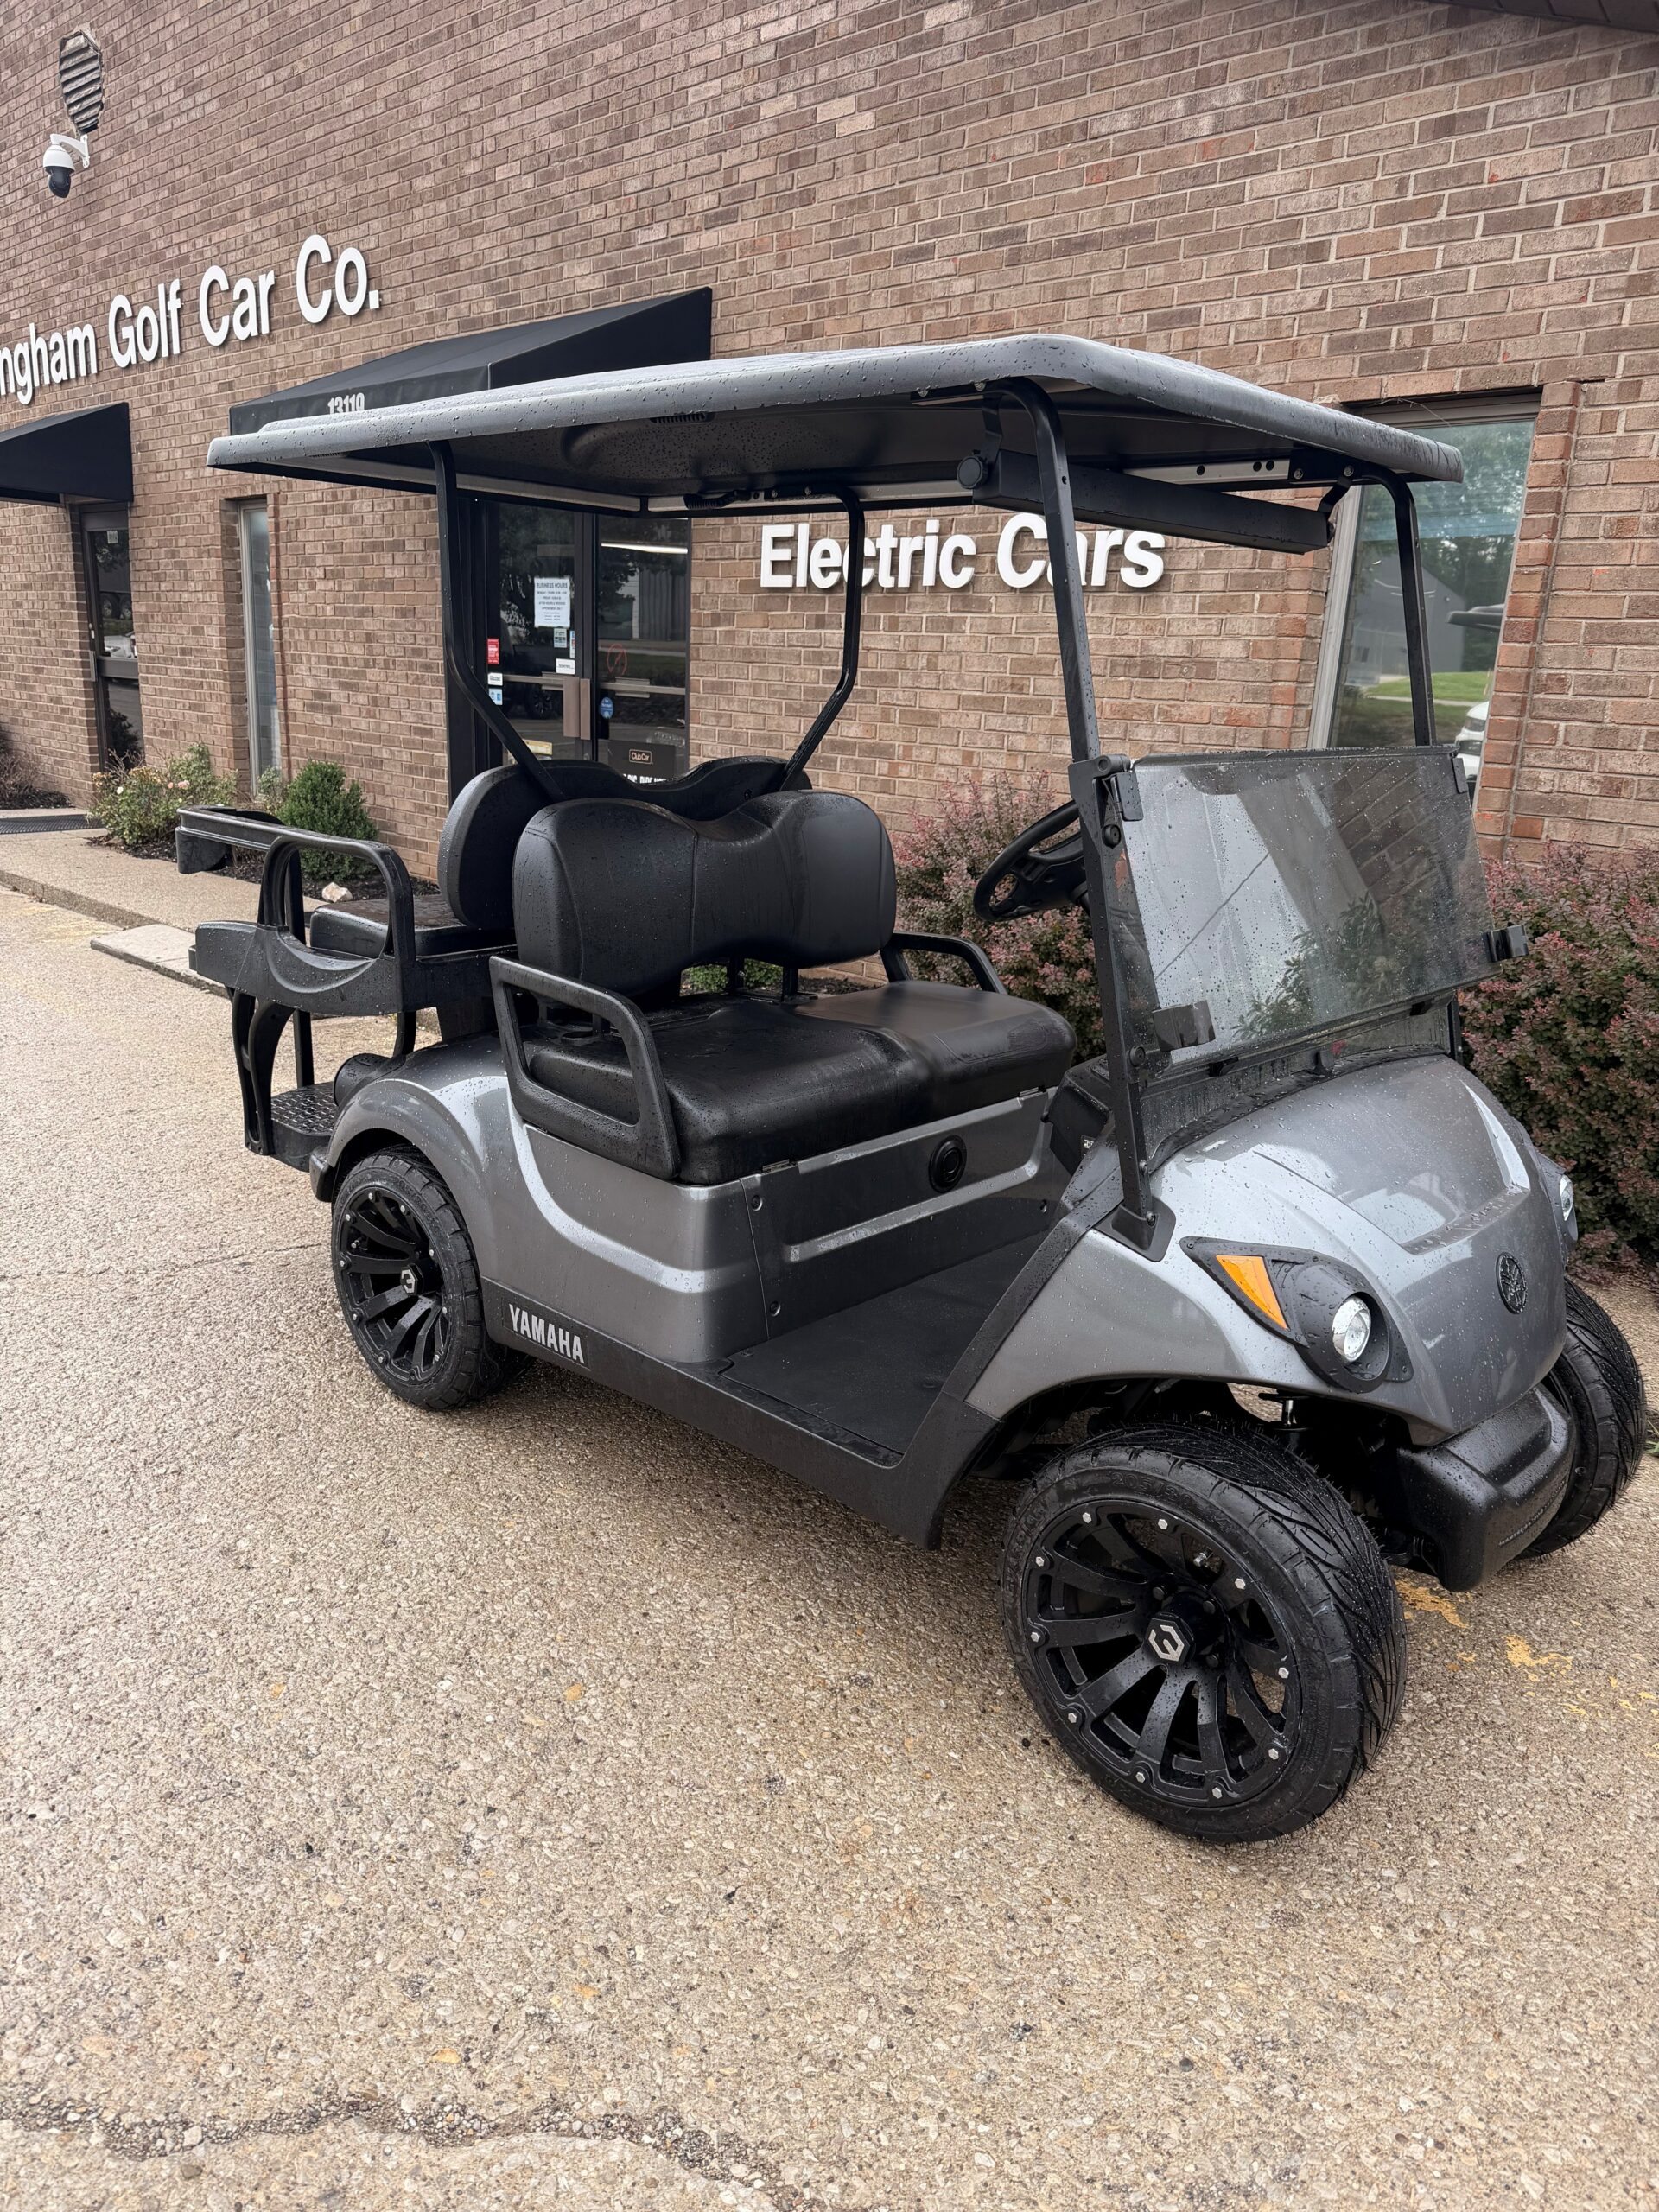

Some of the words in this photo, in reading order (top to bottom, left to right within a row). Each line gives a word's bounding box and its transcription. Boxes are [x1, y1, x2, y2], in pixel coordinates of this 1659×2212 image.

[109, 278, 181, 368] Golf
[200, 265, 275, 346] Car
[296, 234, 379, 323] Co.
[509, 1303, 584, 1363] YAMAHA
